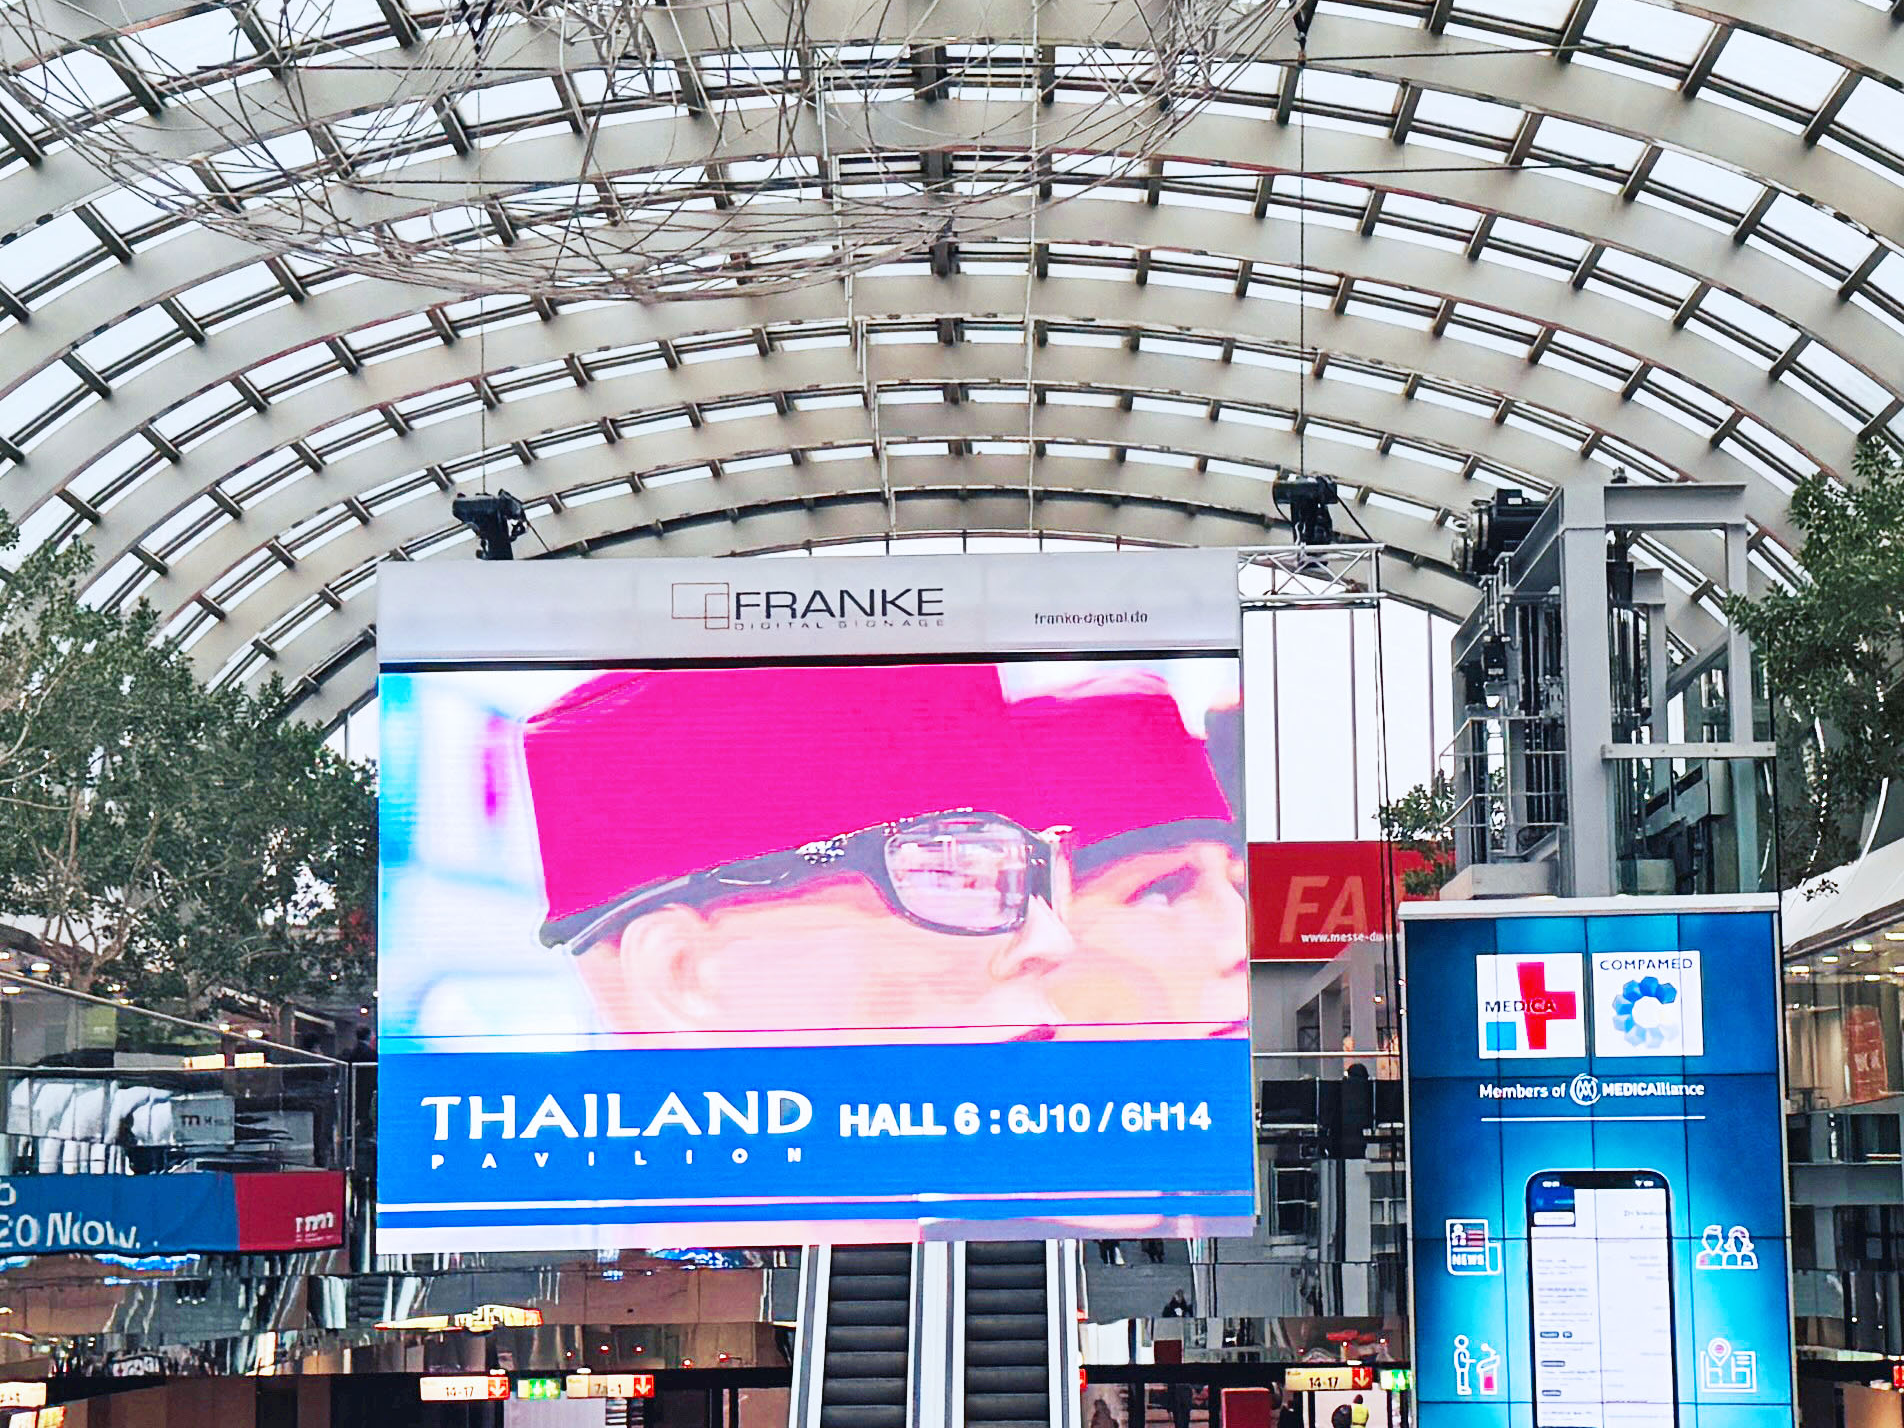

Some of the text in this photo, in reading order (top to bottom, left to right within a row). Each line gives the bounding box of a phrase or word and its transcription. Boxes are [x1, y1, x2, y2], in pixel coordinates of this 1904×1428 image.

[734, 587, 945, 620] FRANKE
[1599, 958, 1693, 971] COMPAMED
[1484, 1000, 1556, 1014] MEDICA
[1479, 1083, 1548, 1099] Members
[1552, 1082, 1566, 1098] of
[420, 1090, 813, 1140] THAILAND
[839, 1102, 947, 1137] HALL
[953, 1102, 980, 1135] 6
[1007, 1103, 1091, 1134] 6J10
[1121, 1102, 1212, 1133] 6H14
[431, 1147, 803, 1171] PAVILION
